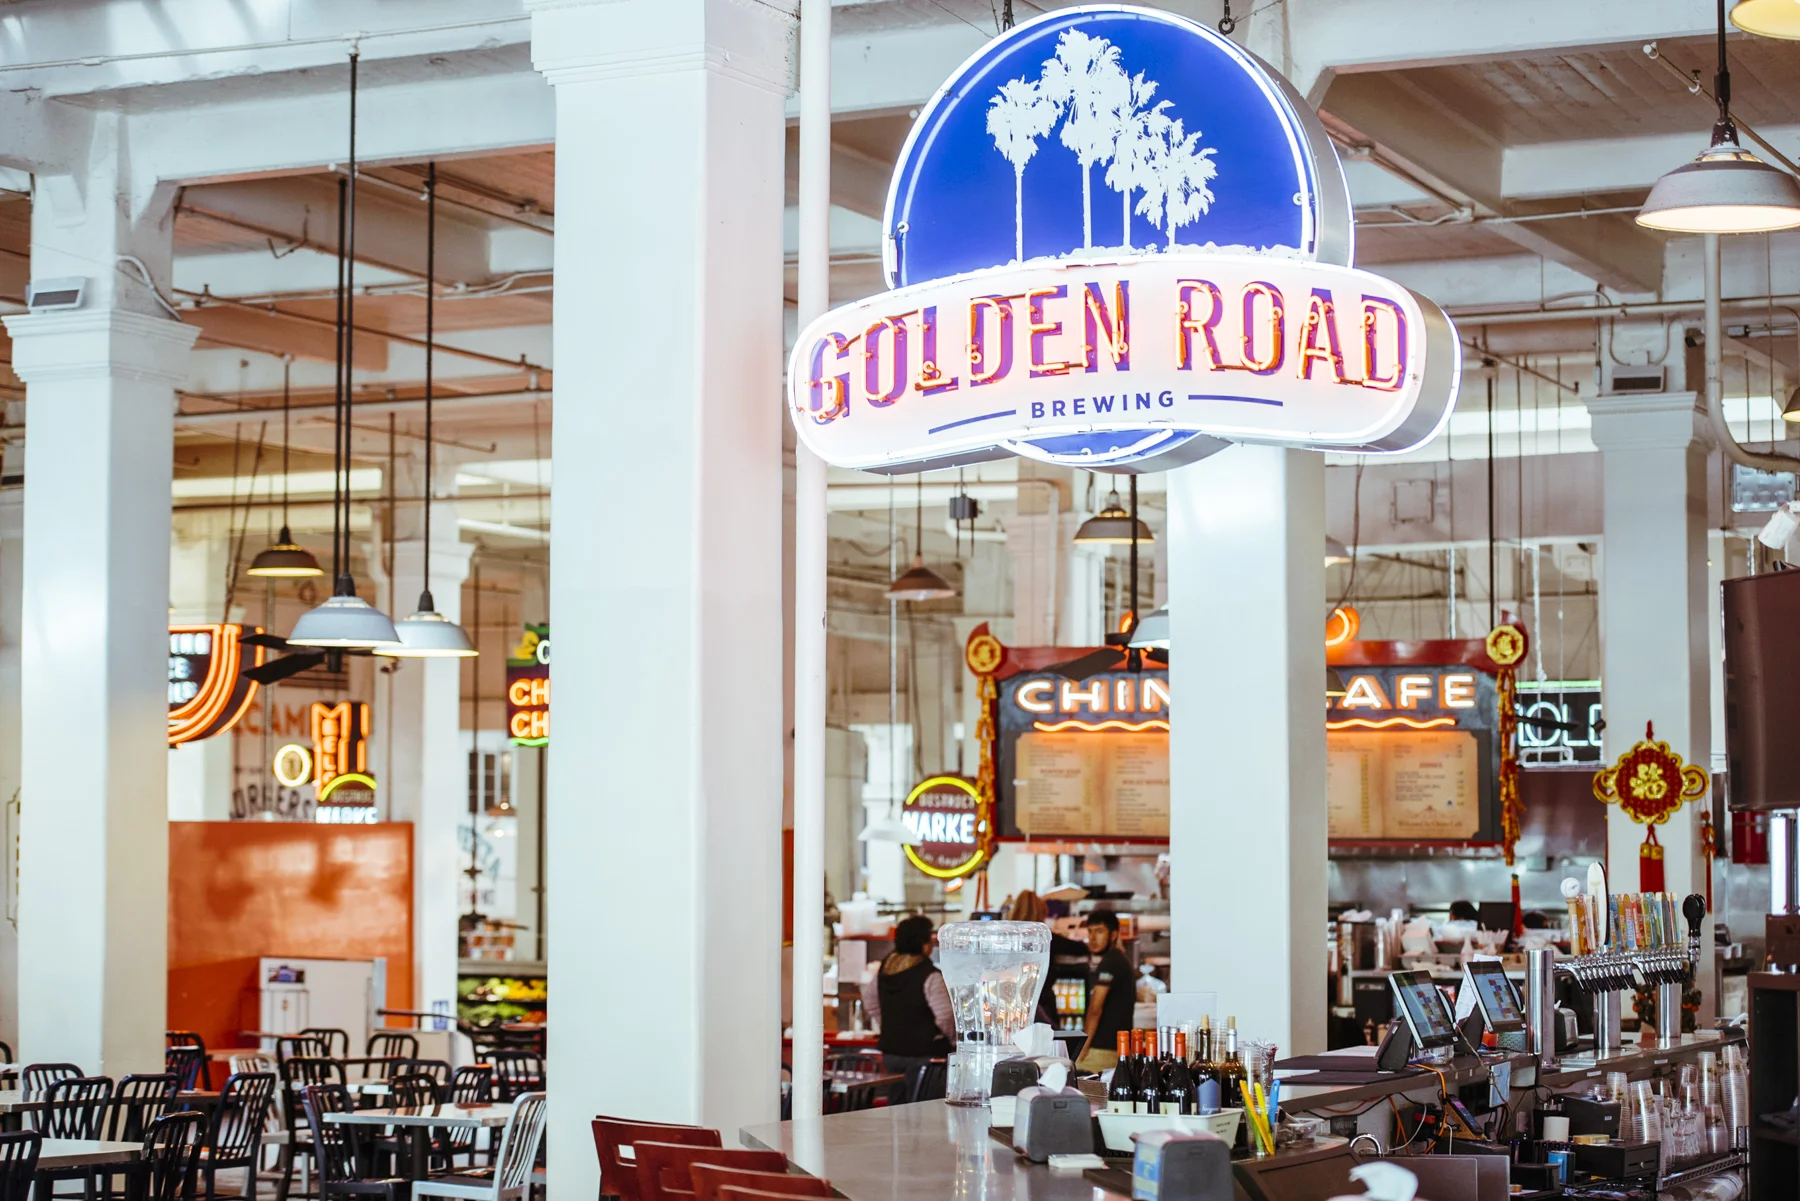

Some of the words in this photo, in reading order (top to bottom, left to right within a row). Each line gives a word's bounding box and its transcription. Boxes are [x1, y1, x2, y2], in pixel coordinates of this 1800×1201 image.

[808, 279, 1131, 425] GOLDEN
[1176, 279, 1409, 392] ROAD
[1031, 390, 1174, 419] BREWING
[1015, 679, 1170, 713] CHIN
[1326, 674, 1476, 710] AFE
[902, 811, 977, 844] MARKE
